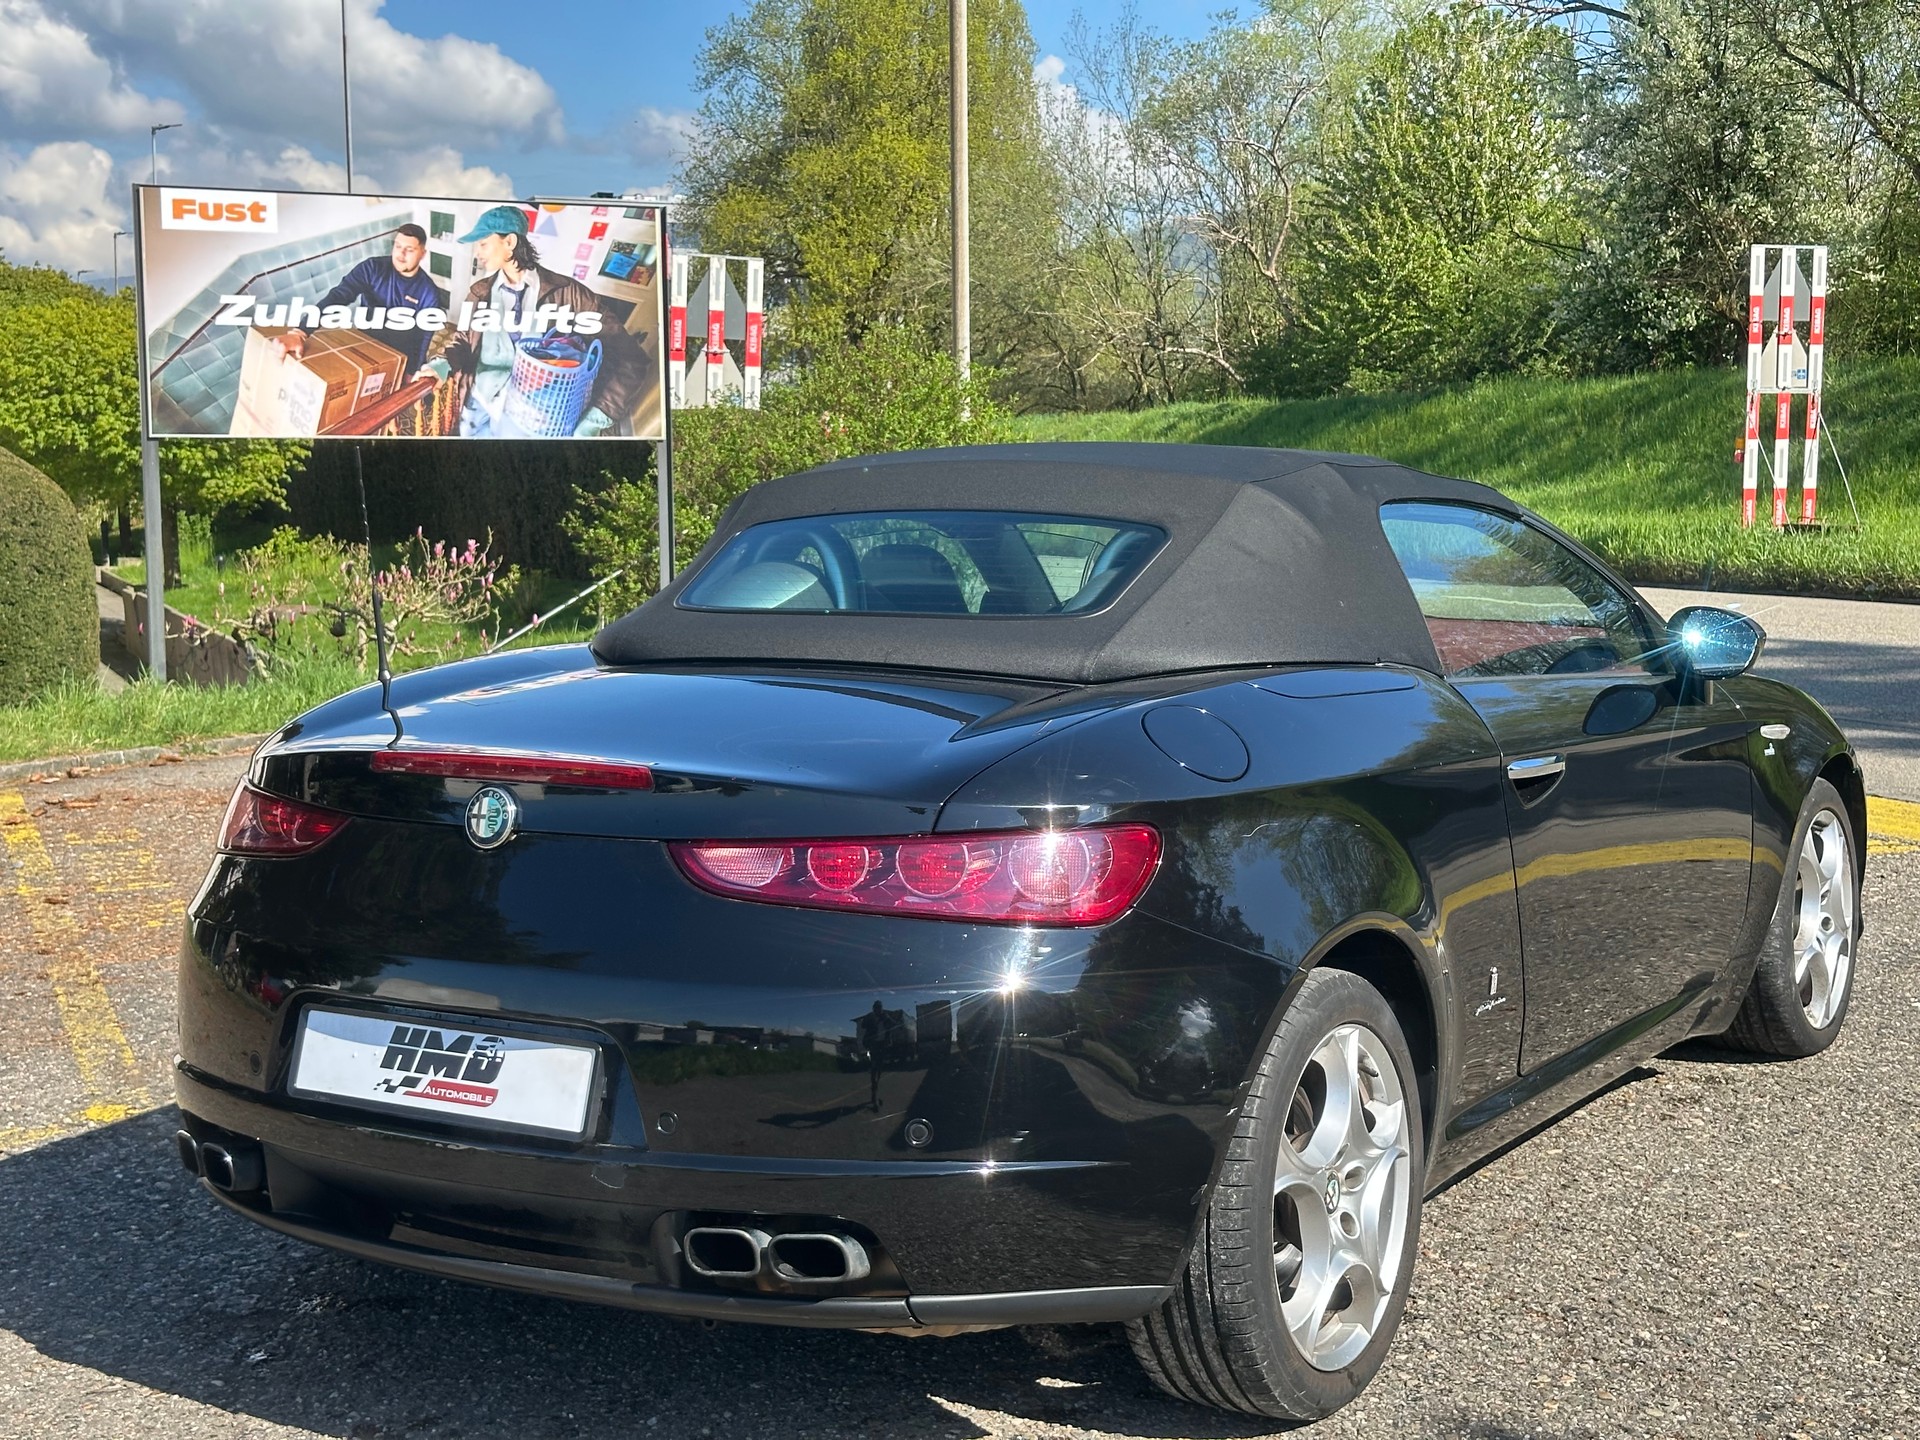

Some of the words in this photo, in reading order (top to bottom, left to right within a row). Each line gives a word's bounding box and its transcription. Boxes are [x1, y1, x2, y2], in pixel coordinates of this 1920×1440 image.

[171, 198, 267, 223] Fust
[214, 294, 447, 333] Zuhause
[459, 300, 604, 336] läufts
[1814, 307, 1822, 334] KIBAG
[673, 319, 683, 349] KIBAG
[749, 324, 758, 353] KIBAG
[423, 1085, 494, 1104] AUTOMOBILE
